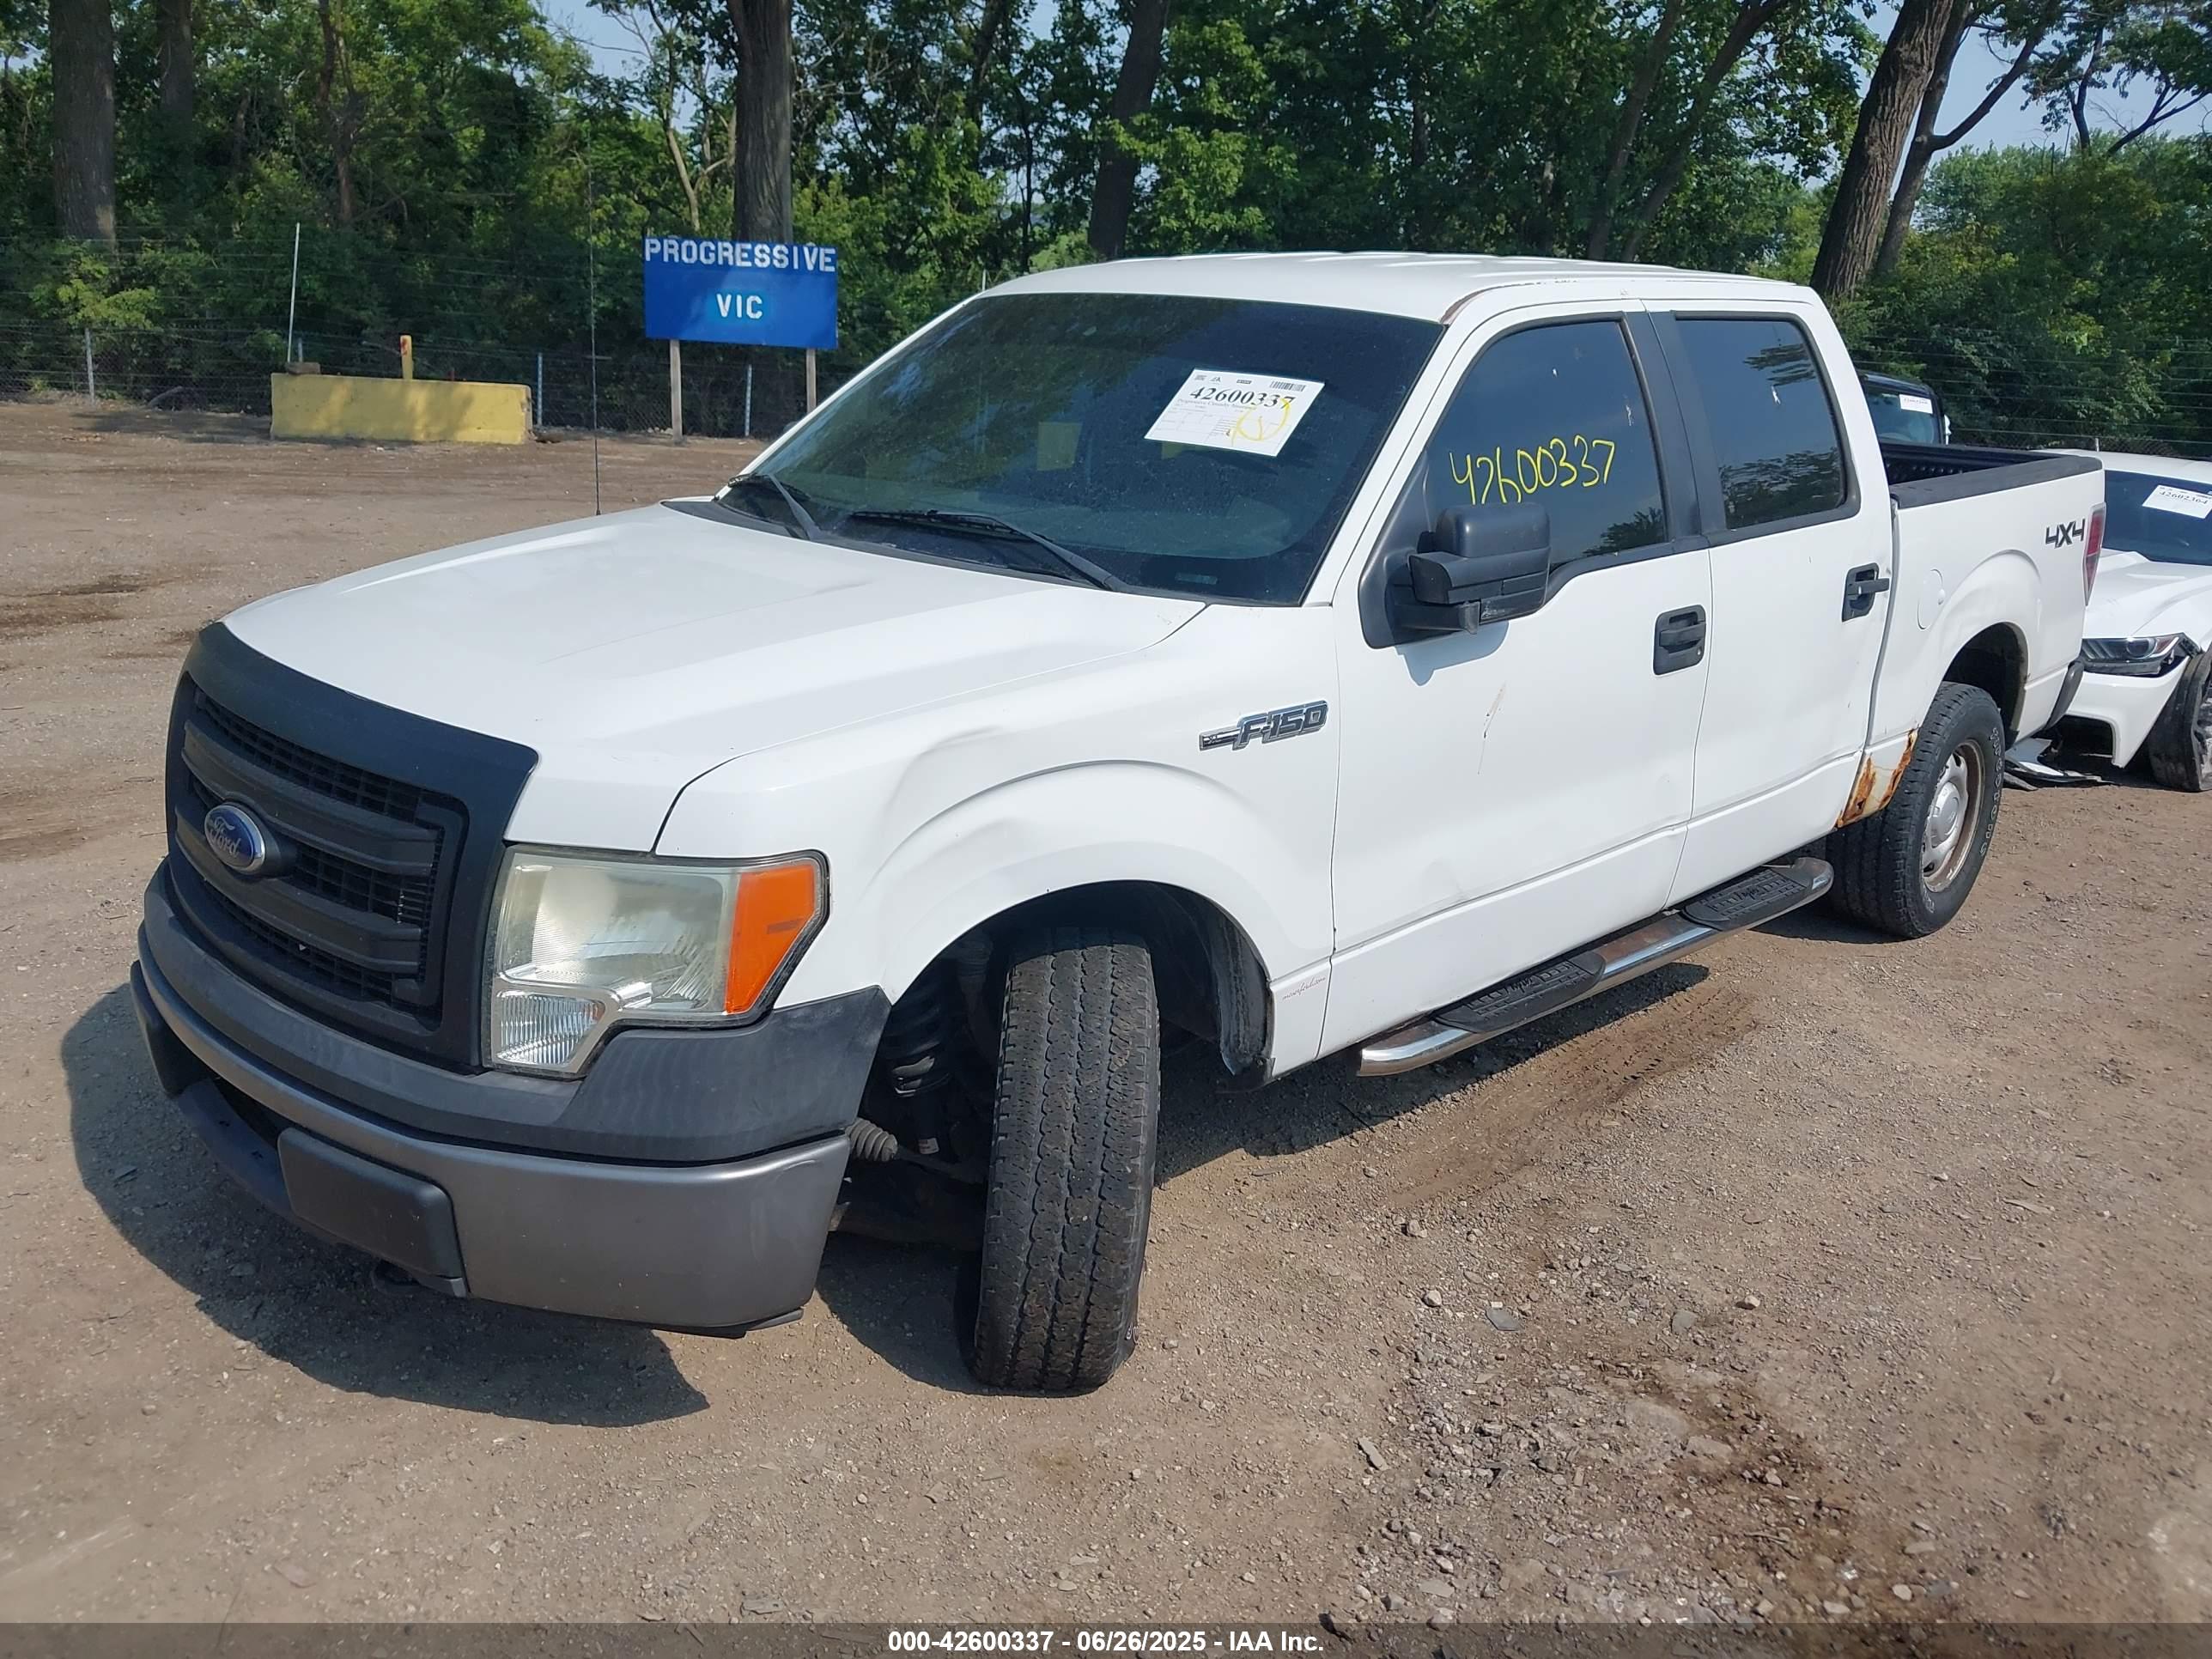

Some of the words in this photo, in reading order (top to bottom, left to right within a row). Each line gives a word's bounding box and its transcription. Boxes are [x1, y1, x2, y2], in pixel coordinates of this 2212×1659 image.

[645, 238, 836, 272] PROGRESSIVE
[716, 293, 763, 319] VIC
[1190, 386, 1296, 410] 42600337
[1449, 434, 1615, 505] 42600337
[1231, 700, 1328, 750] F-150
[209, 816, 242, 859] Ford
